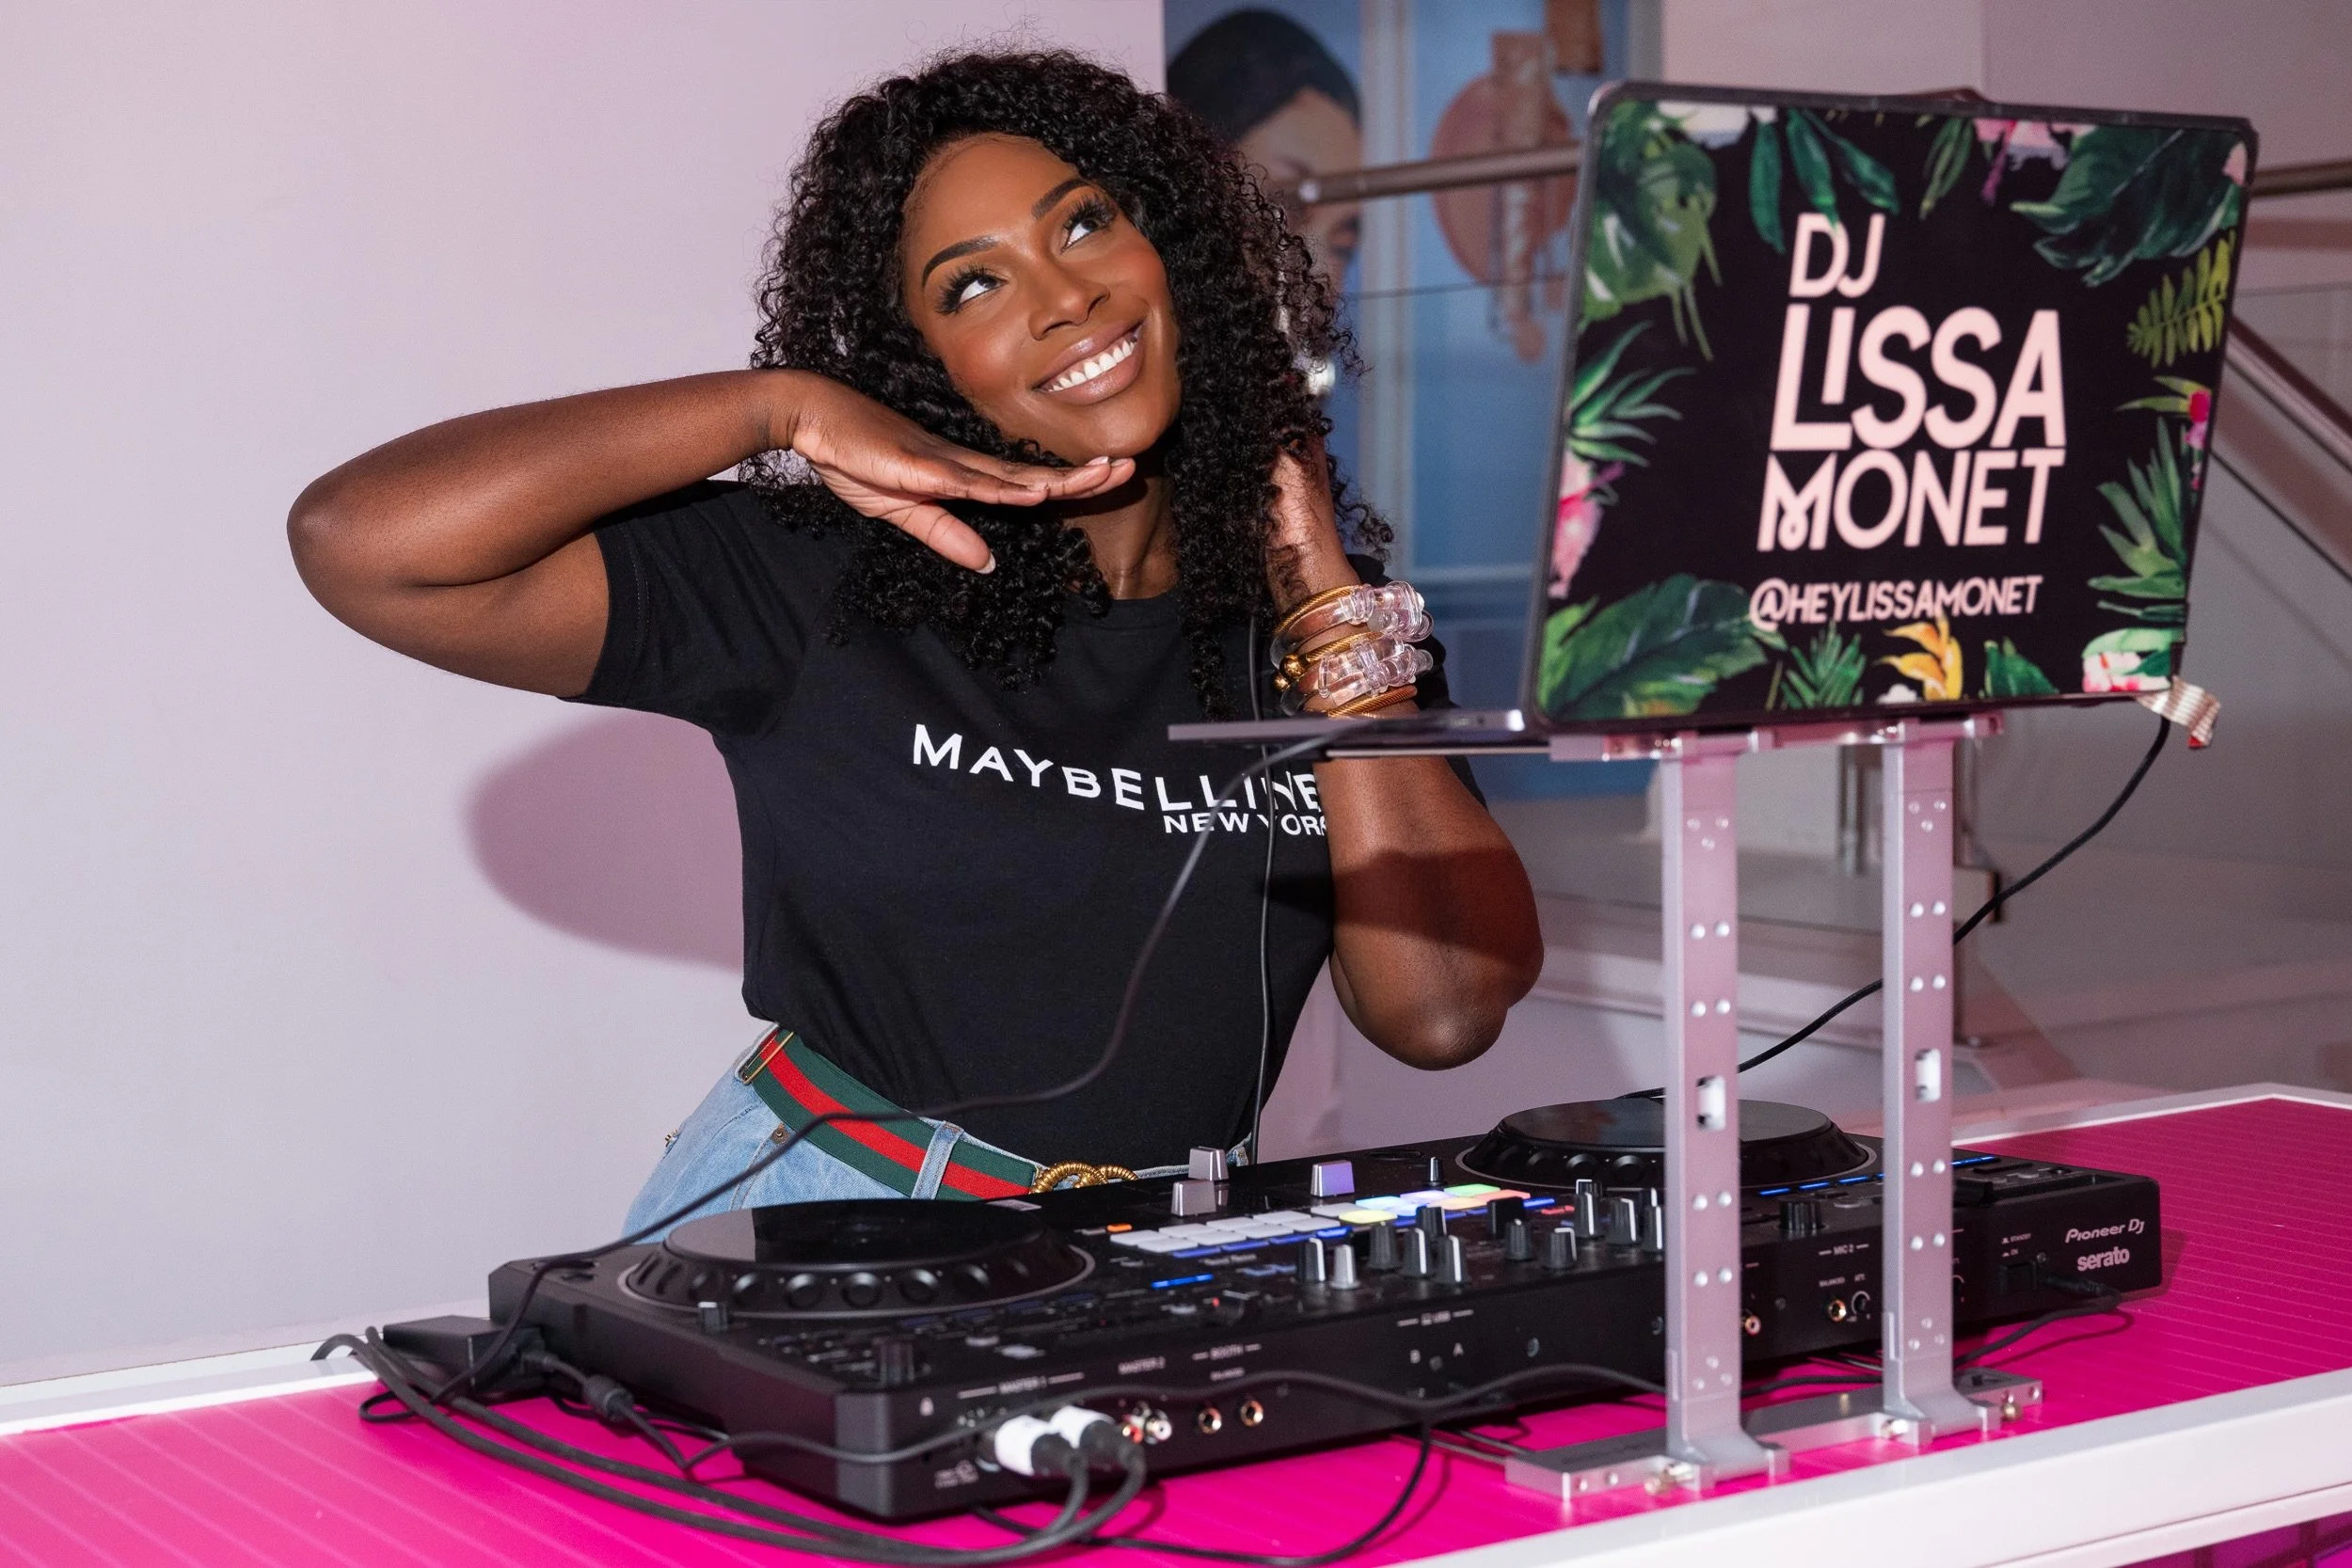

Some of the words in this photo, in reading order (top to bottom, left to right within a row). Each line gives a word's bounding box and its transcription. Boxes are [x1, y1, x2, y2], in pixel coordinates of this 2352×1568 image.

[1789, 213, 1885, 297] DJ
[1770, 304, 2067, 451] LISSA
[1757, 448, 2066, 551] MONET
[1748, 576, 2042, 631] @HEYLISSAMONET
[913, 723, 1321, 813] MAYBELLINE
[1163, 812, 1249, 834] NEW
[2065, 1224, 2125, 1243] Pioneer
[2077, 1246, 2130, 1272] serato
